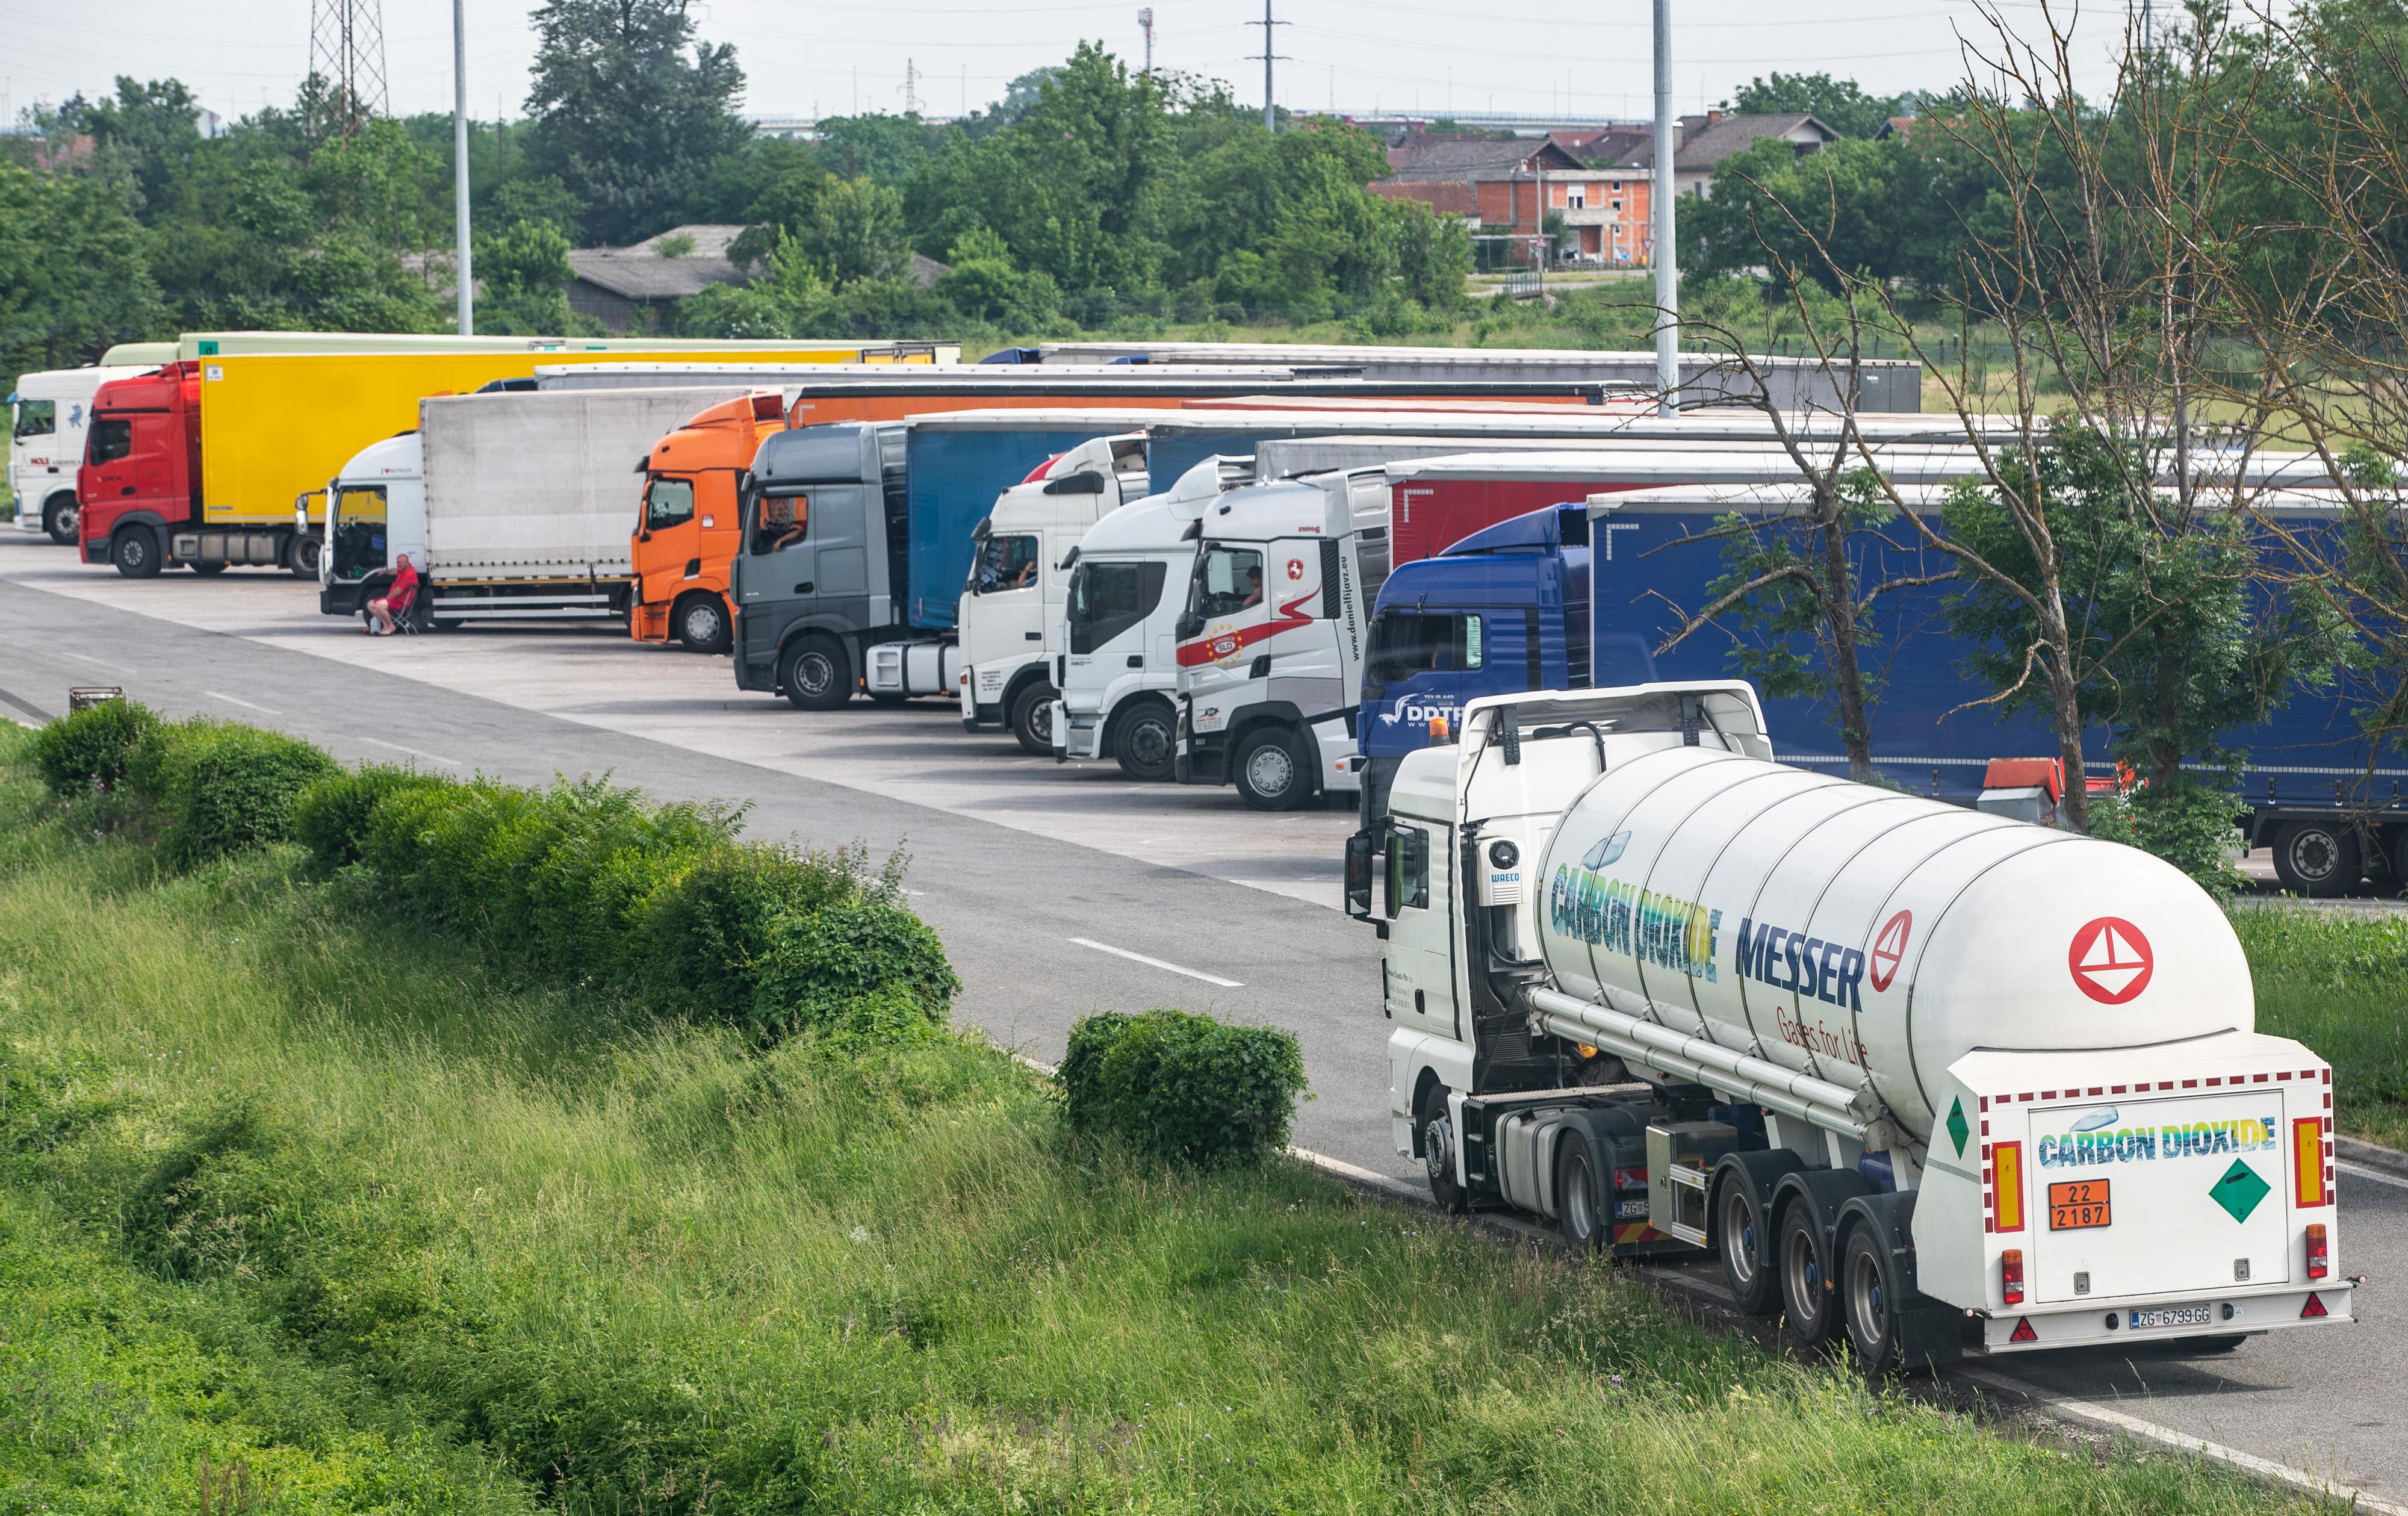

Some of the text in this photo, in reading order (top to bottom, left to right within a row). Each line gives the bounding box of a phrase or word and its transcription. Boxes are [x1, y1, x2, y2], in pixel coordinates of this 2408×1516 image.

[1341, 556, 1359, 662] www.danielfijavz.eu
[1218, 642, 1232, 651] SLO
[1491, 873, 1519, 883] WAECO
[1551, 862, 1723, 984] CARBON DIOXIDE
[1736, 917, 1866, 1013] MESSER
[1777, 1006, 1820, 1053] Gases
[1819, 1020, 1842, 1060] for
[2038, 1117, 2276, 1169] CARBON DIOXIDE
[2068, 1184, 2091, 1203] 22
[1624, 1203, 1637, 1215] ZG
[2057, 1206, 2104, 1226] 2187
[2140, 1313, 2155, 1326] ZG
